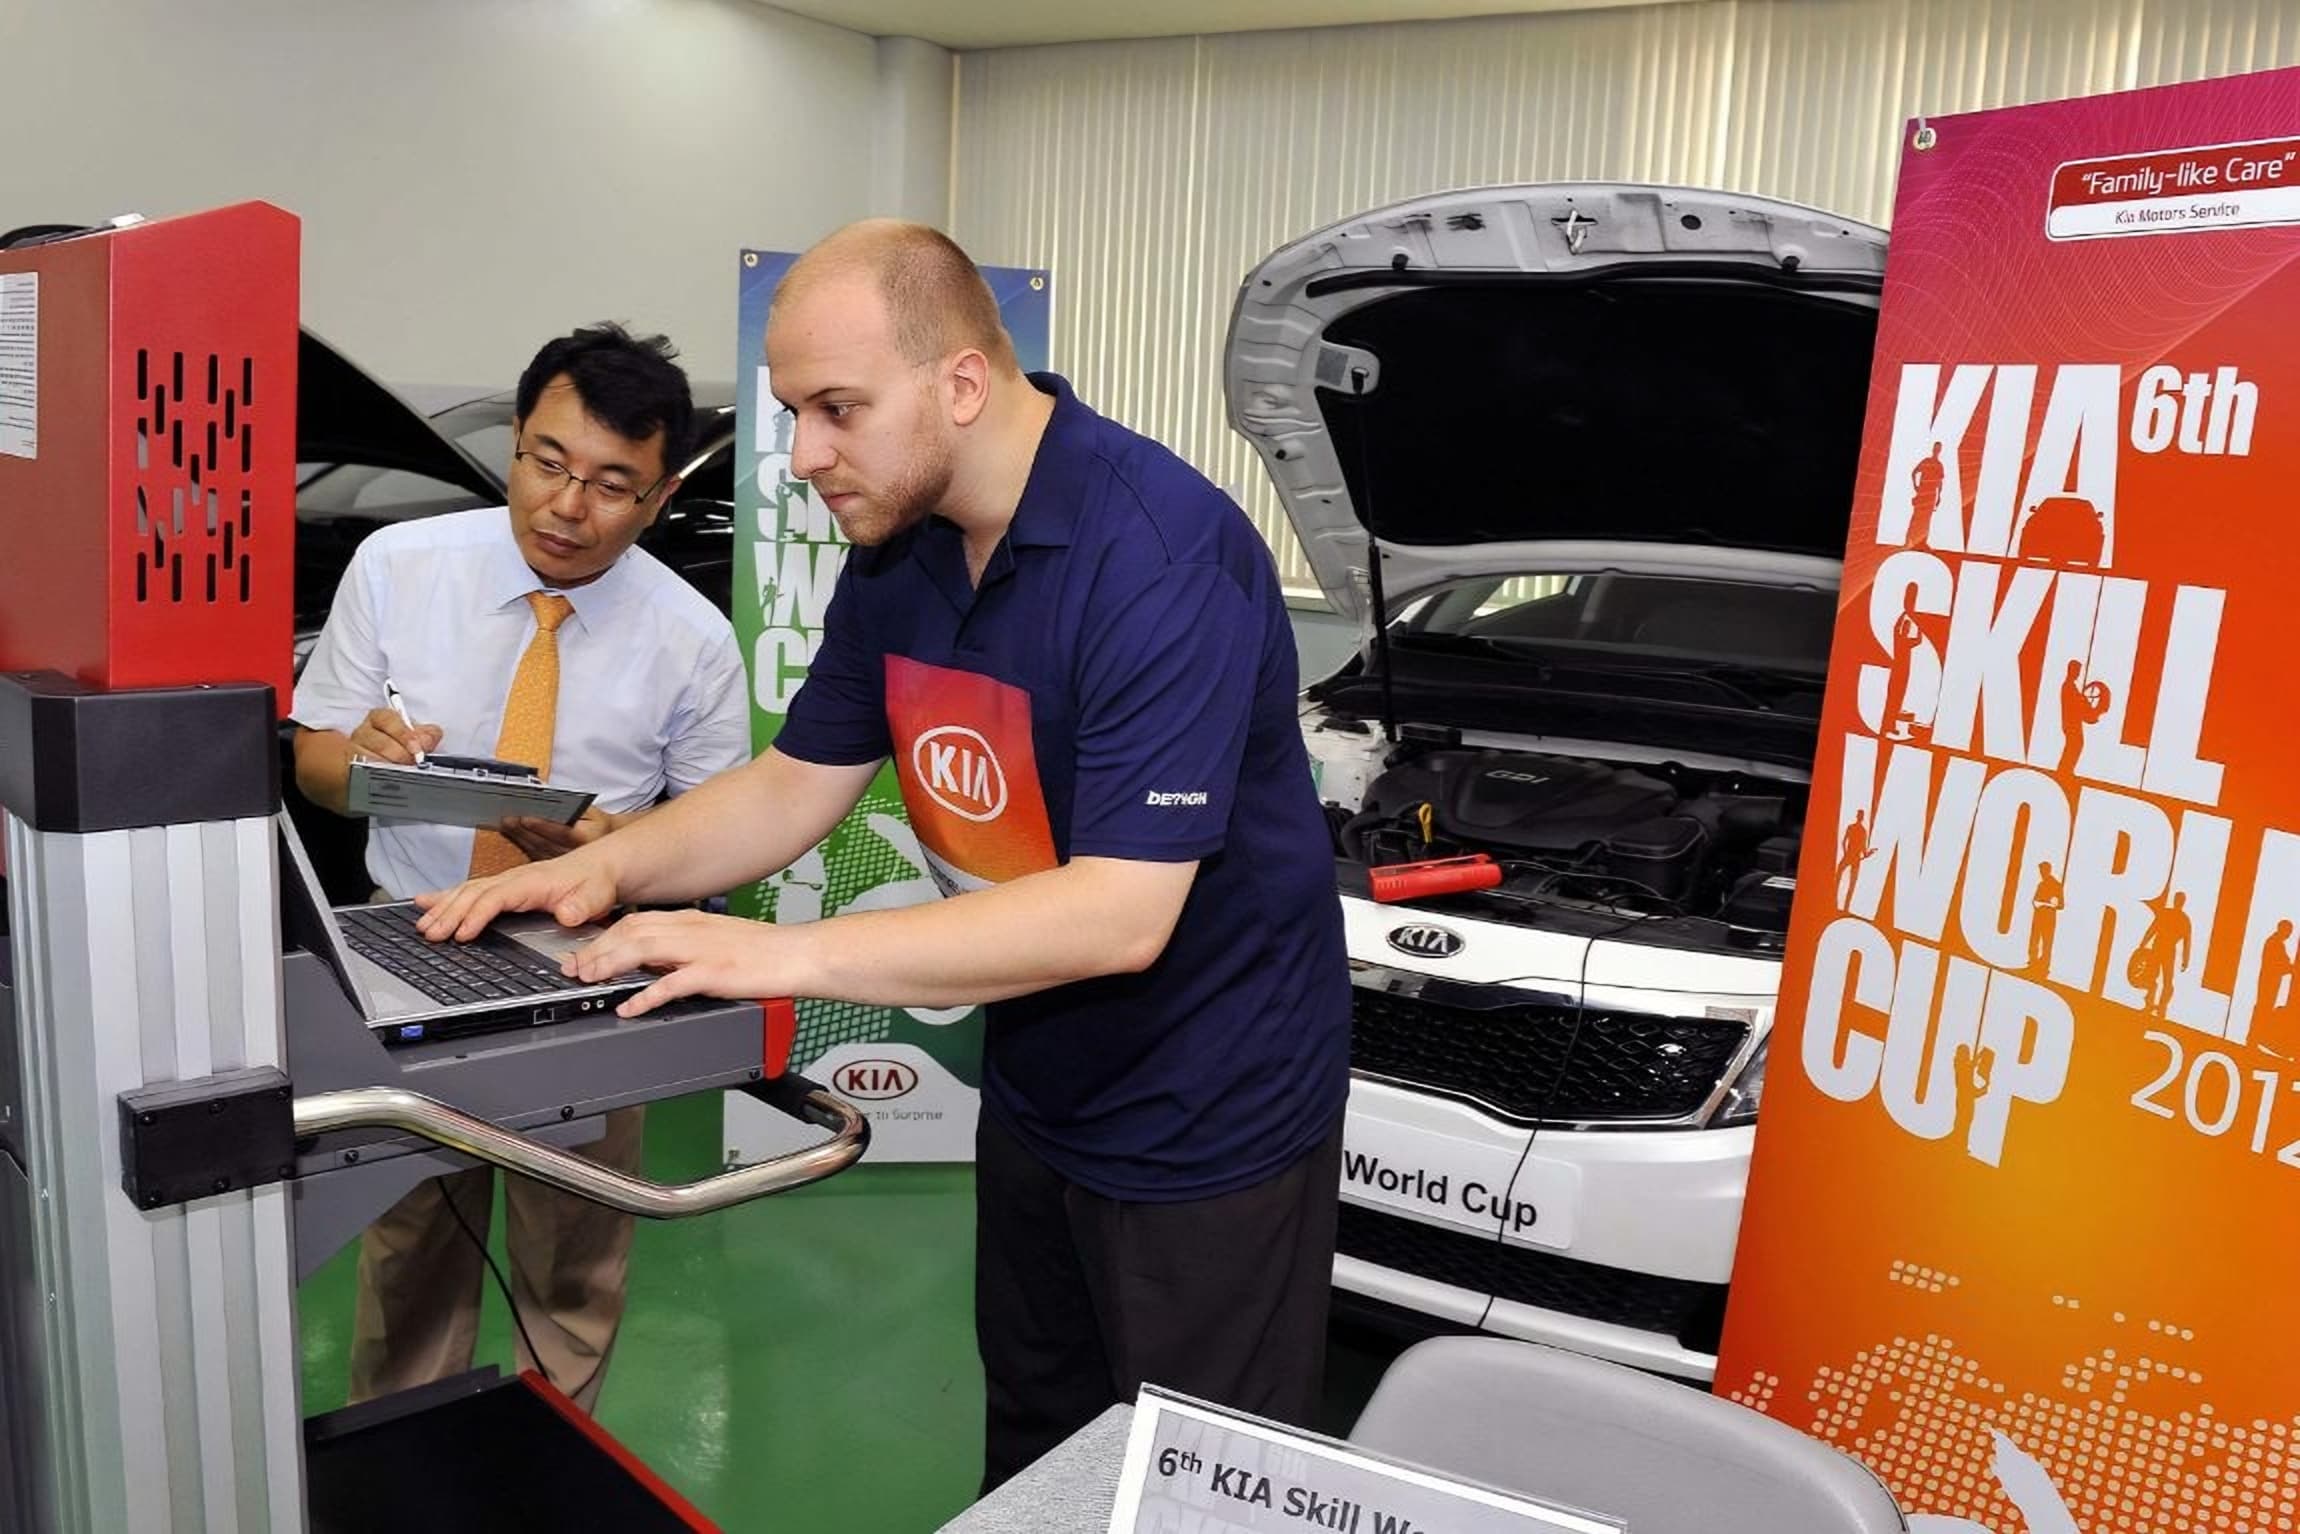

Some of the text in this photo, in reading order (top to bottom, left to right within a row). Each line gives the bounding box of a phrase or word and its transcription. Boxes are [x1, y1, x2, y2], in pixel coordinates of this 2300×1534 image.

[2115, 202, 2241, 225] Kia Motors Service
[1876, 363, 2260, 568] KIA 6th
[1857, 551, 2226, 806] SKILL
[929, 740, 993, 809] KIA
[1397, 928, 1449, 953] KIA
[848, 1069, 904, 1091] KIA
[1801, 917, 2075, 1167] CUP
[1344, 1150, 1538, 1232] World Cup
[1157, 1446, 1202, 1478] 6th
[1210, 1463, 1273, 1510] KIA
[1283, 1486, 1361, 1534] Skill
